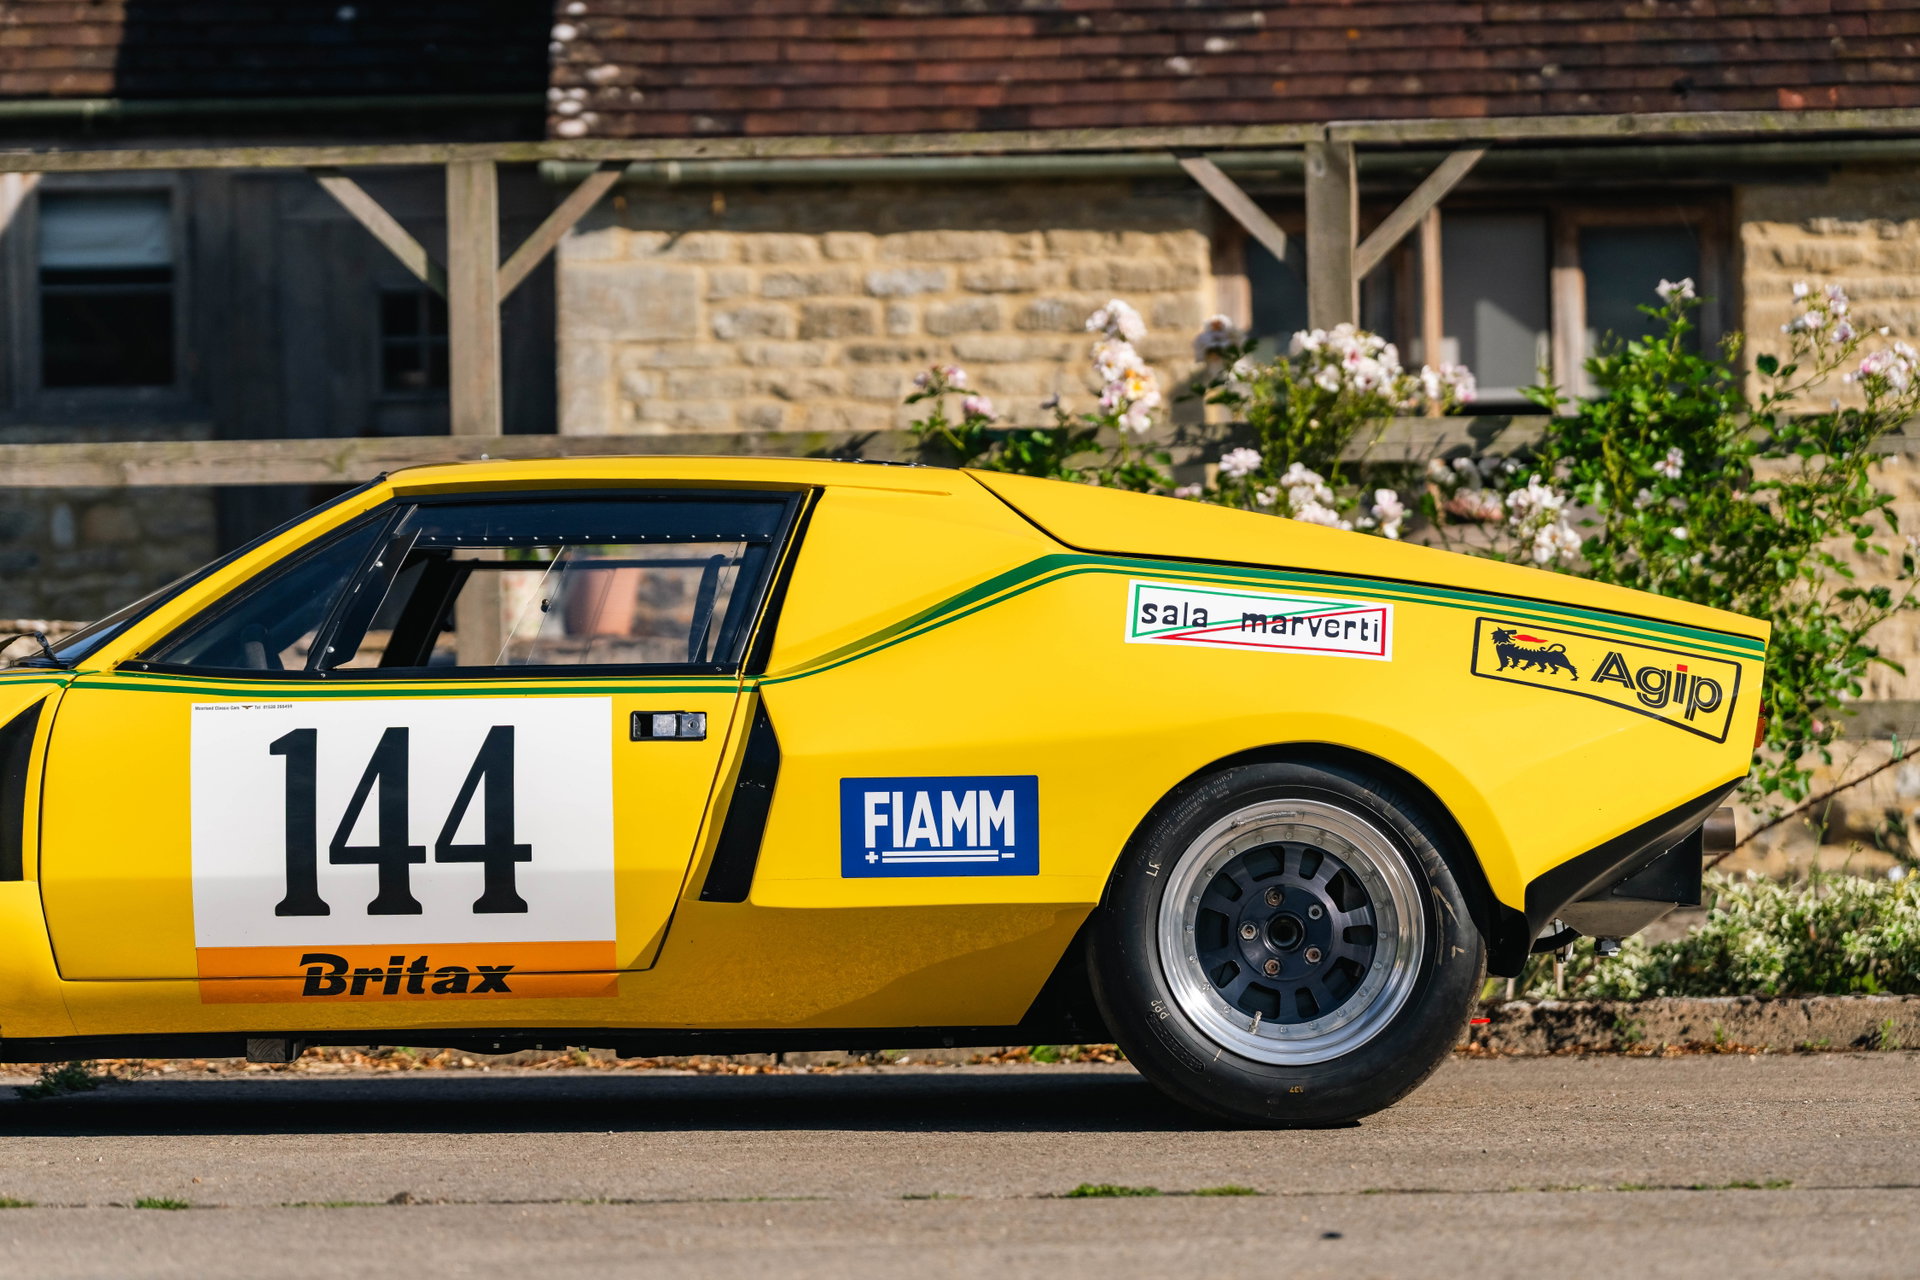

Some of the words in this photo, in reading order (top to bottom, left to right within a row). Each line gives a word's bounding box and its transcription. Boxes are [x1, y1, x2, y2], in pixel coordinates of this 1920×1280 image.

[1141, 602, 1208, 628] sala
[1241, 611, 1379, 643] marverti
[1590, 651, 1723, 722] Agip
[269, 725, 532, 916] 144
[864, 789, 1016, 848] FIAMM
[299, 953, 515, 997] Britax
